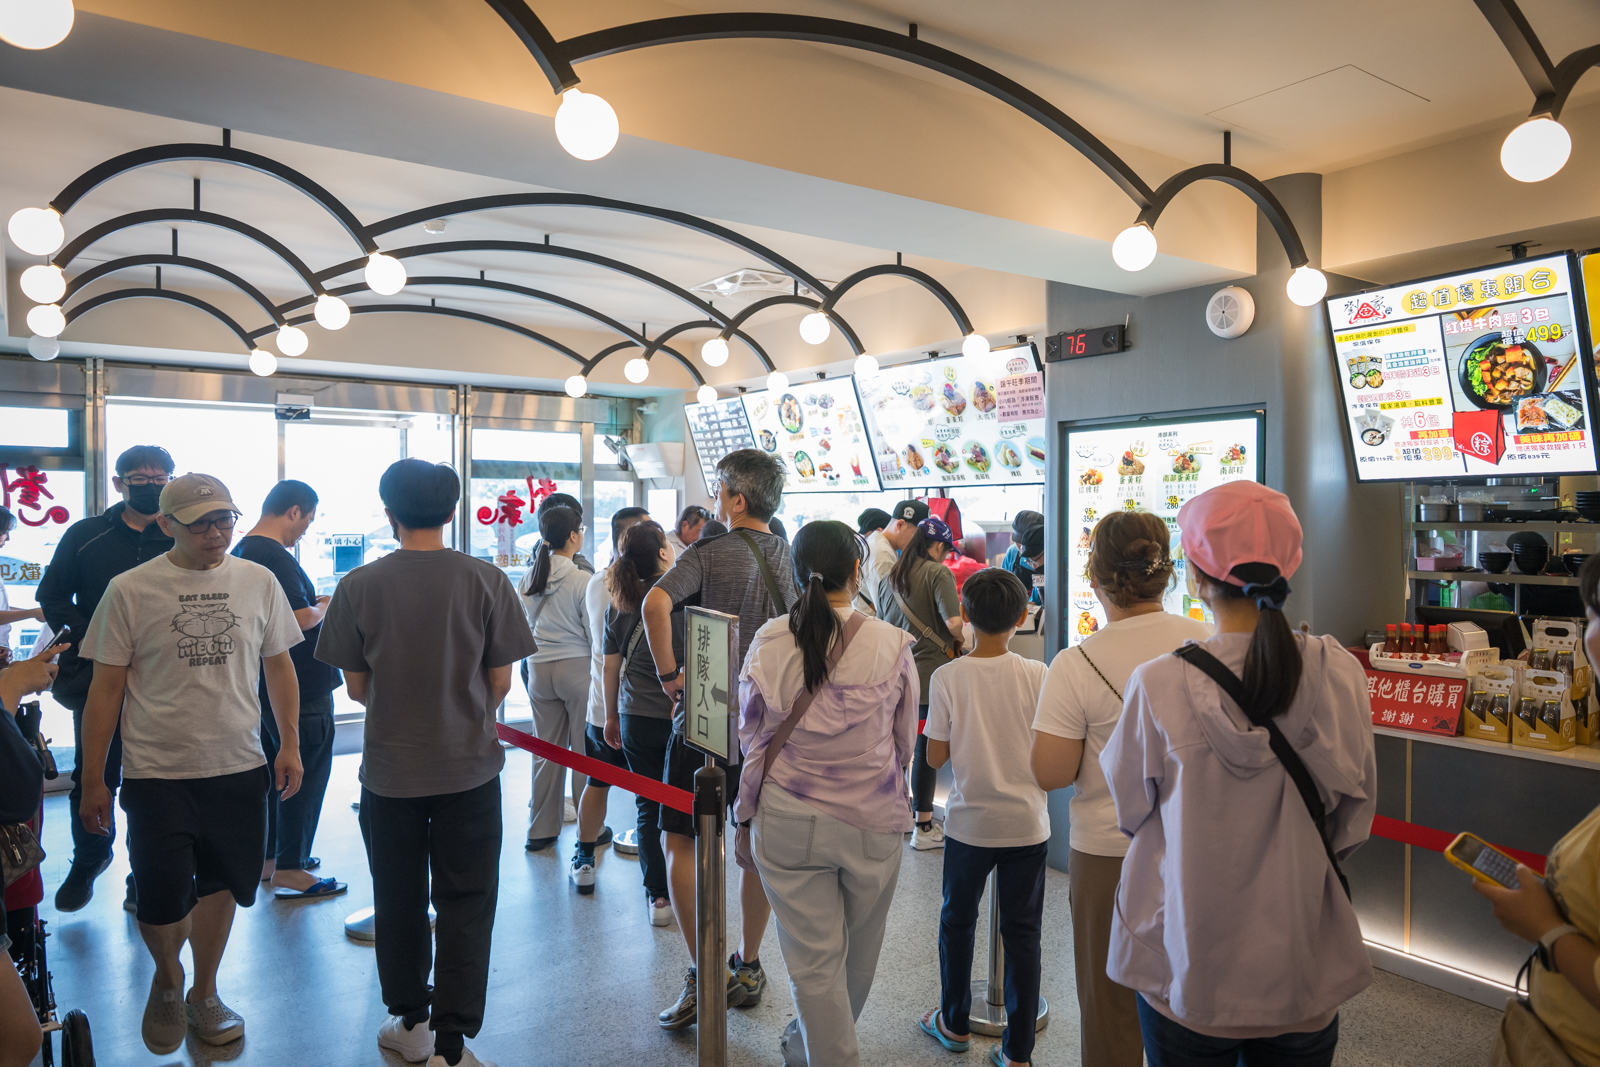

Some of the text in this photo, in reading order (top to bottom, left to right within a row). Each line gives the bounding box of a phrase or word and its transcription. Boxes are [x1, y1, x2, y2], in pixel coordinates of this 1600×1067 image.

[1410, 271, 1551, 311] 超值優惠組合
[1445, 307, 1551, 335] 紅燒牛肉麵3包
[1066, 333, 1087, 355] 76
[1400, 411, 1440, 429] 共6包
[1417, 429, 1450, 440] 再加碼
[1519, 431, 1582, 444] 美味再加碼
[1162, 473, 1199, 483] 南部蛋黃粽
[1219, 466, 1244, 475] 南部粽
[1119, 475, 1143, 485] 蛋黃粽
[178, 592, 230, 602] EAT SLEEP
[178, 640, 237, 659] MEOW
[188, 655, 228, 667] REPEAT
[697, 624, 711, 740] 排隊入口
[1367, 675, 1463, 710] 其他櫃台購買
